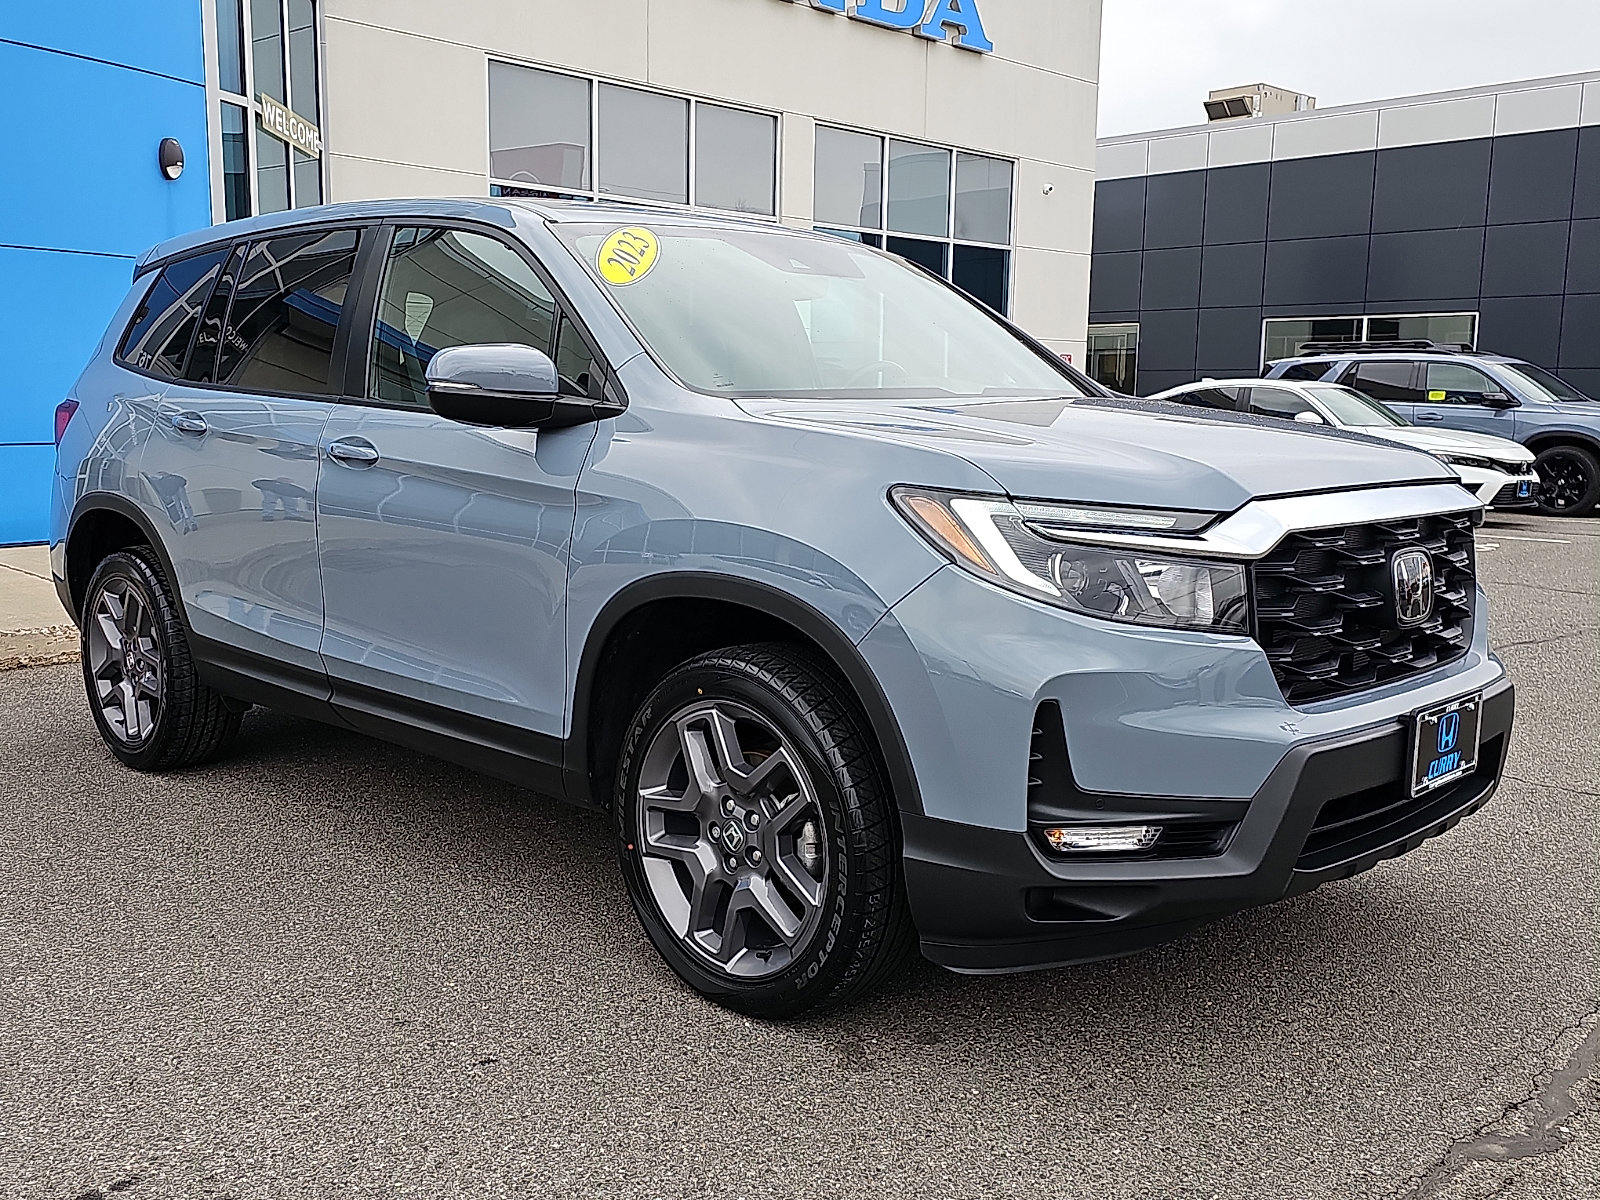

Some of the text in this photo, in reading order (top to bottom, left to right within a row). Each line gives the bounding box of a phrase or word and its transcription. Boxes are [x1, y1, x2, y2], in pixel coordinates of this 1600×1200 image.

[262, 99, 319, 155] WELCOME
[607, 231, 650, 276] 2023
[618, 702, 655, 840] MILESTAR
[1428, 750, 1462, 779] CURRY
[794, 800, 848, 990] INTERCEPTOR
